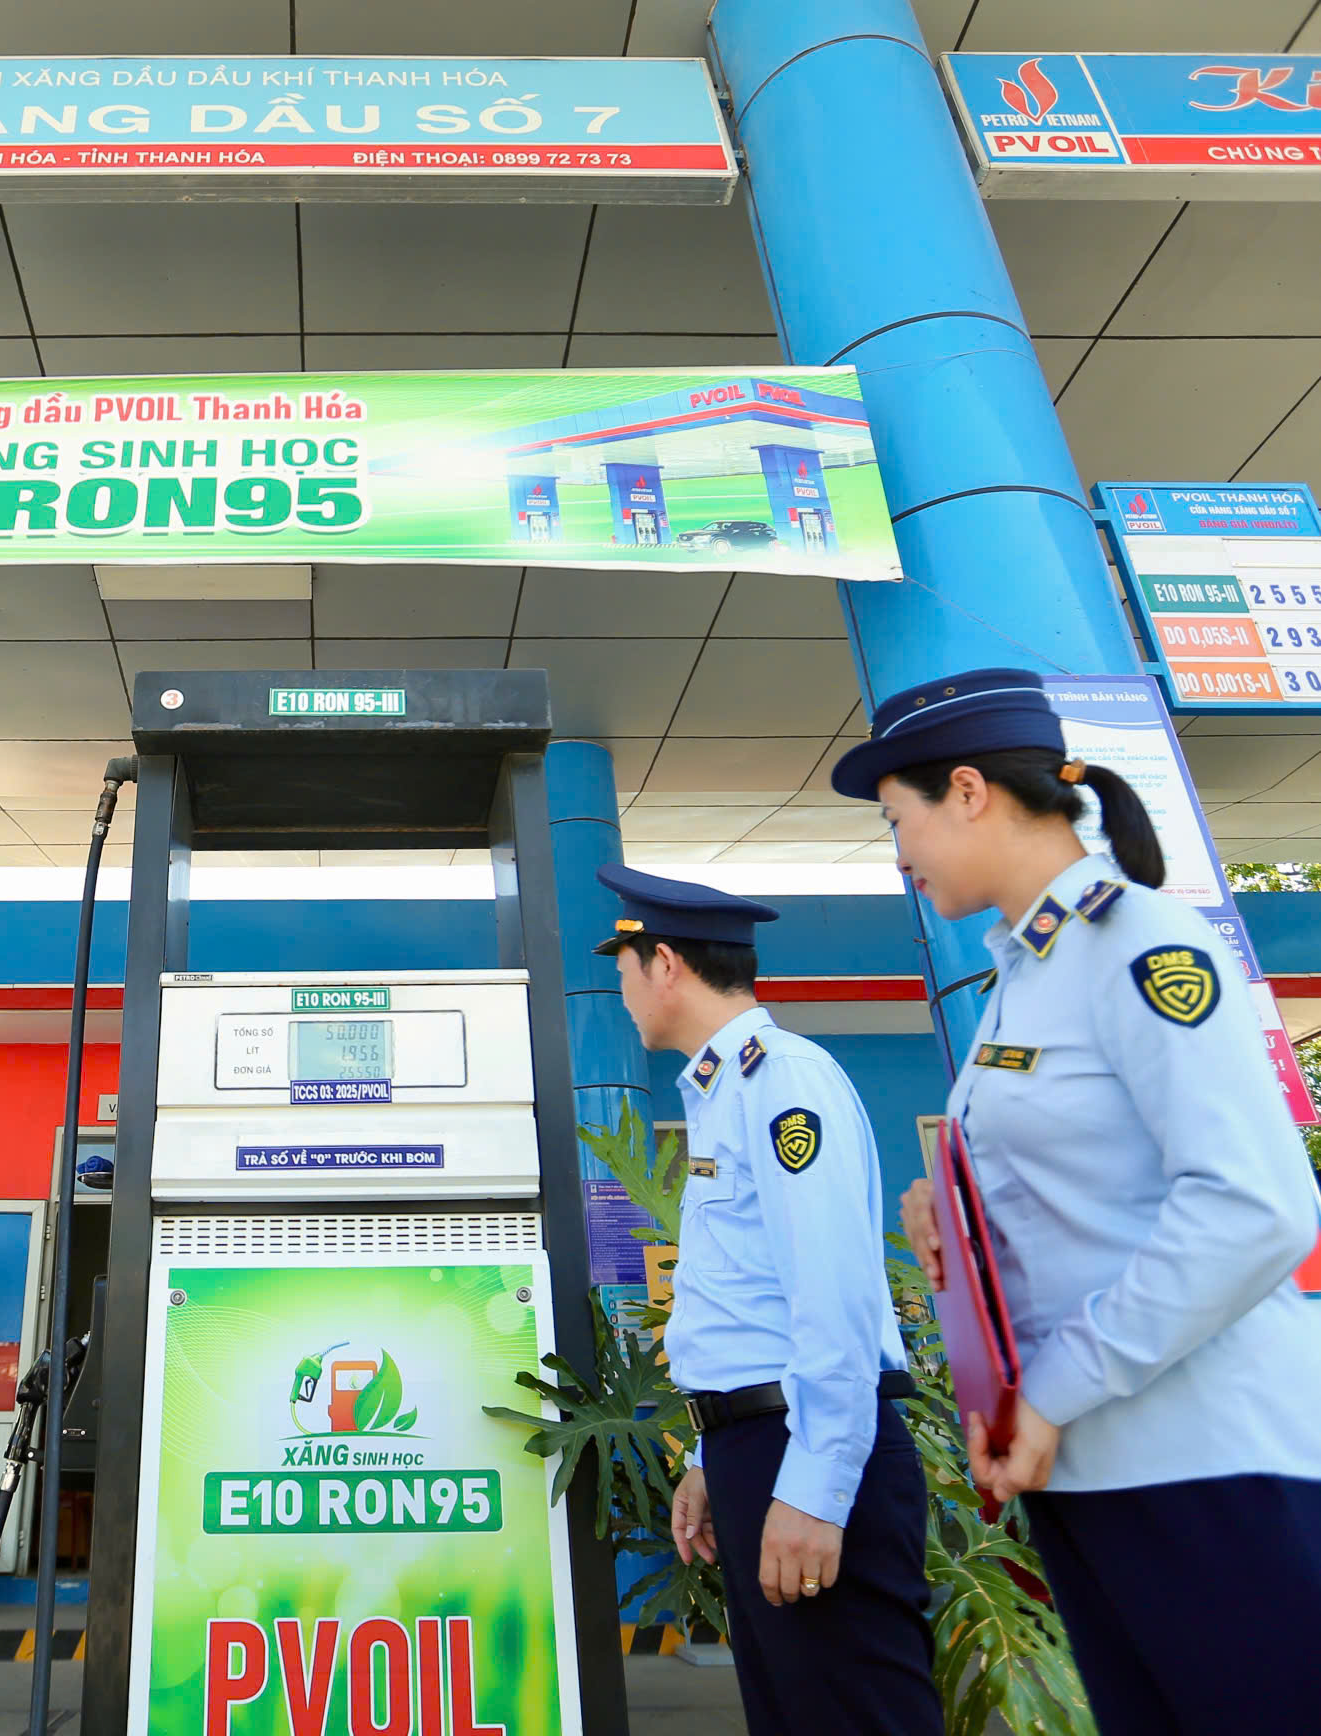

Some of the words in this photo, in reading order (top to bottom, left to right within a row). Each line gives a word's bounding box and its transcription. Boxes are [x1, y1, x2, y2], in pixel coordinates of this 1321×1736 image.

[11, 68, 102, 87] XĂNG
[112, 64, 177, 86] DẦU
[188, 64, 252, 86] DẦU
[263, 67, 313, 86] KHÍ
[323, 71, 430, 86] THANH
[442, 67, 508, 86] HÓA
[190, 93, 380, 134] DẦU
[416, 94, 542, 134] SỐ
[574, 106, 620, 134] 7
[10, 149, 56, 164] HÓA
[78, 148, 128, 163] TỈNH
[135, 152, 211, 163] THANH
[219, 150, 265, 163] HÓA
[353, 149, 405, 166] ĐIỆN
[412, 152, 485, 167] THOẠI:
[492, 153, 540, 165] 0899
[547, 153, 571, 165] 72
[576, 153, 601, 165] 73
[607, 154, 631, 166] 73
[1207, 143, 1304, 160] CHÚNG
[690, 385, 746, 408] PVOIL
[23, 393, 81, 425] dầu
[95, 398, 182, 423] PVOIL
[193, 396, 291, 420] Thanh
[305, 394, 362, 420] Hóa
[80, 438, 216, 470] SINH
[241, 438, 360, 474] HỌC
[1171, 493, 1215, 502] PVOIL
[1217, 493, 1267, 502] THANH
[1271, 491, 1304, 503] HÓA
[1154, 584, 1178, 602] E10
[1179, 584, 1204, 602] RON
[1207, 584, 1239, 602] 95-III
[1163, 626, 1184, 645] DO
[1188, 626, 1249, 648] 0,05S-II
[1176, 672, 1199, 692] DO
[1202, 673, 1272, 696] 0,001S-V
[166, 693, 178, 706] 3
[277, 692, 308, 711] E10
[314, 692, 349, 712] RON
[354, 692, 399, 712] 95-III
[1147, 951, 1194, 970] DMS
[296, 993, 319, 1007] E10
[322, 993, 350, 1007] RON
[354, 992, 385, 1006] 95-III
[294, 1085, 317, 1100] TCCS
[319, 1085, 334, 1100] 03:
[336, 1083, 389, 1099] 2025/PVOIL
[780, 1113, 807, 1131] DMS
[244, 1150, 268, 1166] TRẢ
[271, 1149, 288, 1165] SỐ
[291, 1147, 308, 1165] VỀ
[335, 1150, 377, 1163] TRƯỚC
[382, 1153, 403, 1163] KHI
[406, 1151, 435, 1163] BƠM
[281, 1440, 350, 1466] XĂNG
[352, 1452, 388, 1466] SINH
[392, 1452, 424, 1468] HỌC
[220, 1478, 303, 1526] E10
[319, 1477, 490, 1525] RON95
[205, 1616, 507, 1736] PVOIL
